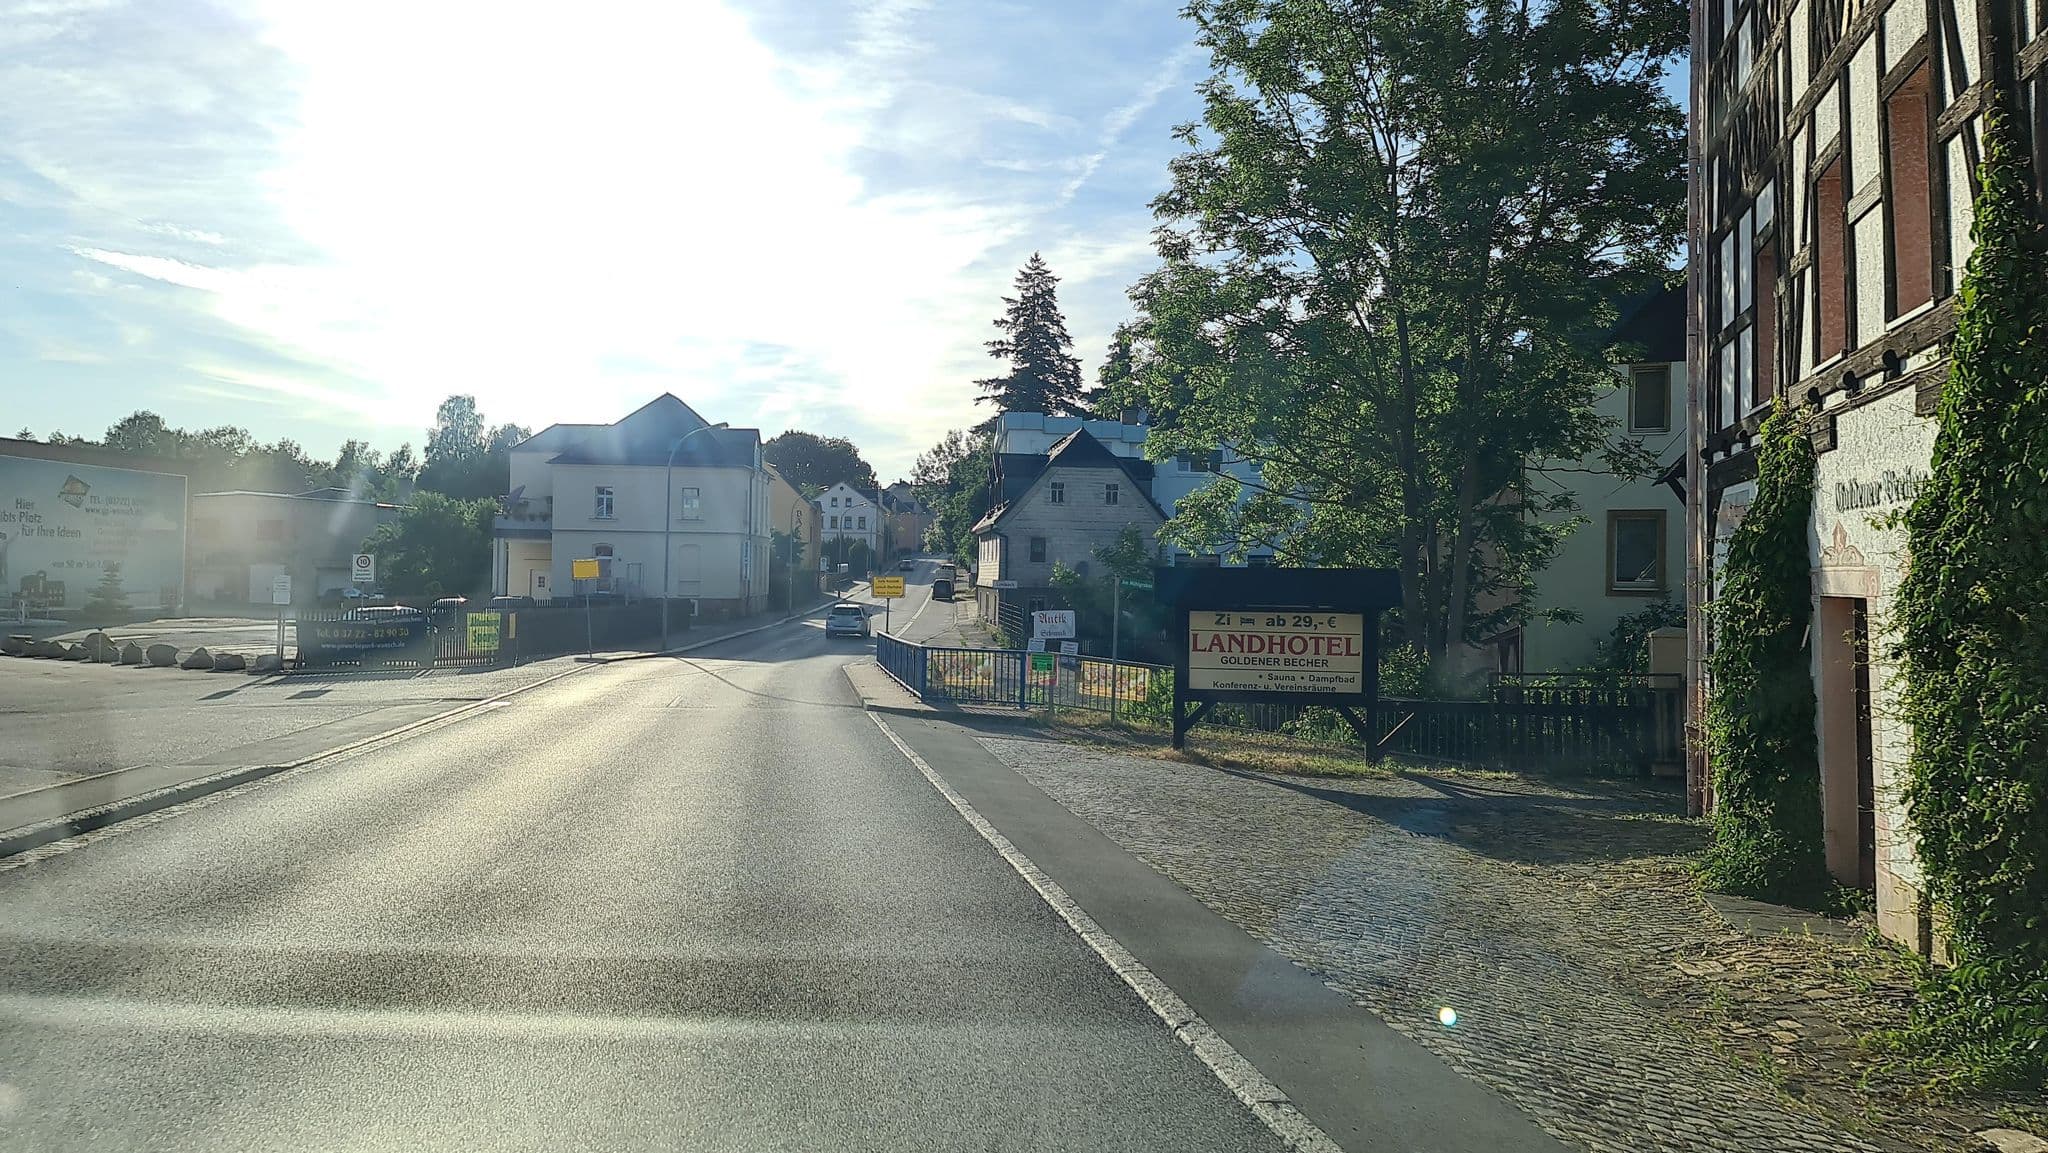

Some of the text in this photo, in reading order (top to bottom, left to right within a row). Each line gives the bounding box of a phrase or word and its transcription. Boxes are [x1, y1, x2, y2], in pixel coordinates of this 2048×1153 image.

[15, 498, 35, 511] Hier
[19, 511, 43, 524] Platz
[21, 524, 81, 539] für Ihre Ideen
[1039, 611, 1068, 625] Antik
[1214, 613, 1337, 631] Zi ab 29,- €
[316, 629, 331, 638] Tel.
[333, 629, 340, 638] 0
[342, 629, 351, 638] 37
[354, 629, 365, 639] 22
[374, 629, 384, 639] 82
[386, 628, 397, 637] 90
[1191, 633, 1361, 657] LANDHOTEL
[1220, 656, 1329, 668] GOLDENER BECHER
[1267, 673, 1355, 684] Sauna Dampfbad
[1212, 680, 1262, 690] Konferenz-
[1274, 682, 1337, 693] Vereinsräume
